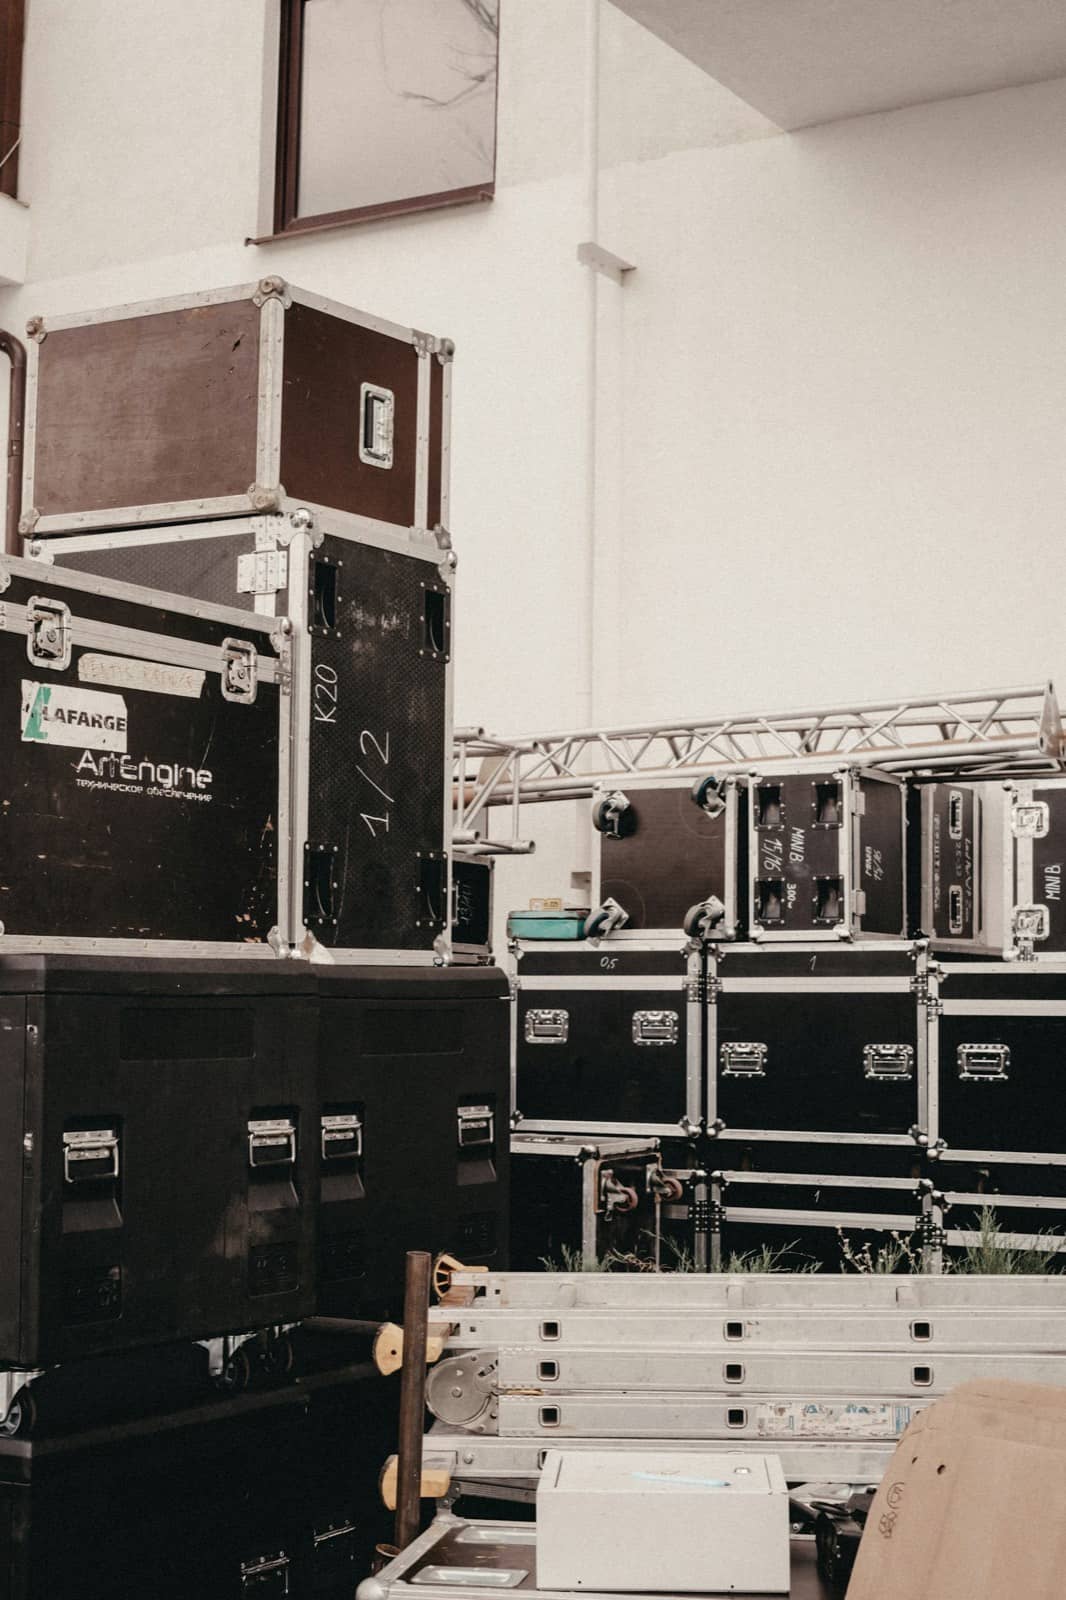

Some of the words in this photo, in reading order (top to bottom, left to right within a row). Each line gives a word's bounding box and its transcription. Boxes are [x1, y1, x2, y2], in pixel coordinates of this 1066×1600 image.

[314, 664, 339, 724] K20
[41, 705, 126, 732] LAFARGE
[75, 749, 213, 789] ArtEngine
[355, 731, 395, 838] 1/2
[761, 838, 784, 872] 15/16
[789, 827, 806, 853] MINI
[1043, 865, 1061, 874] B
[1043, 875, 1061, 901] MINI
